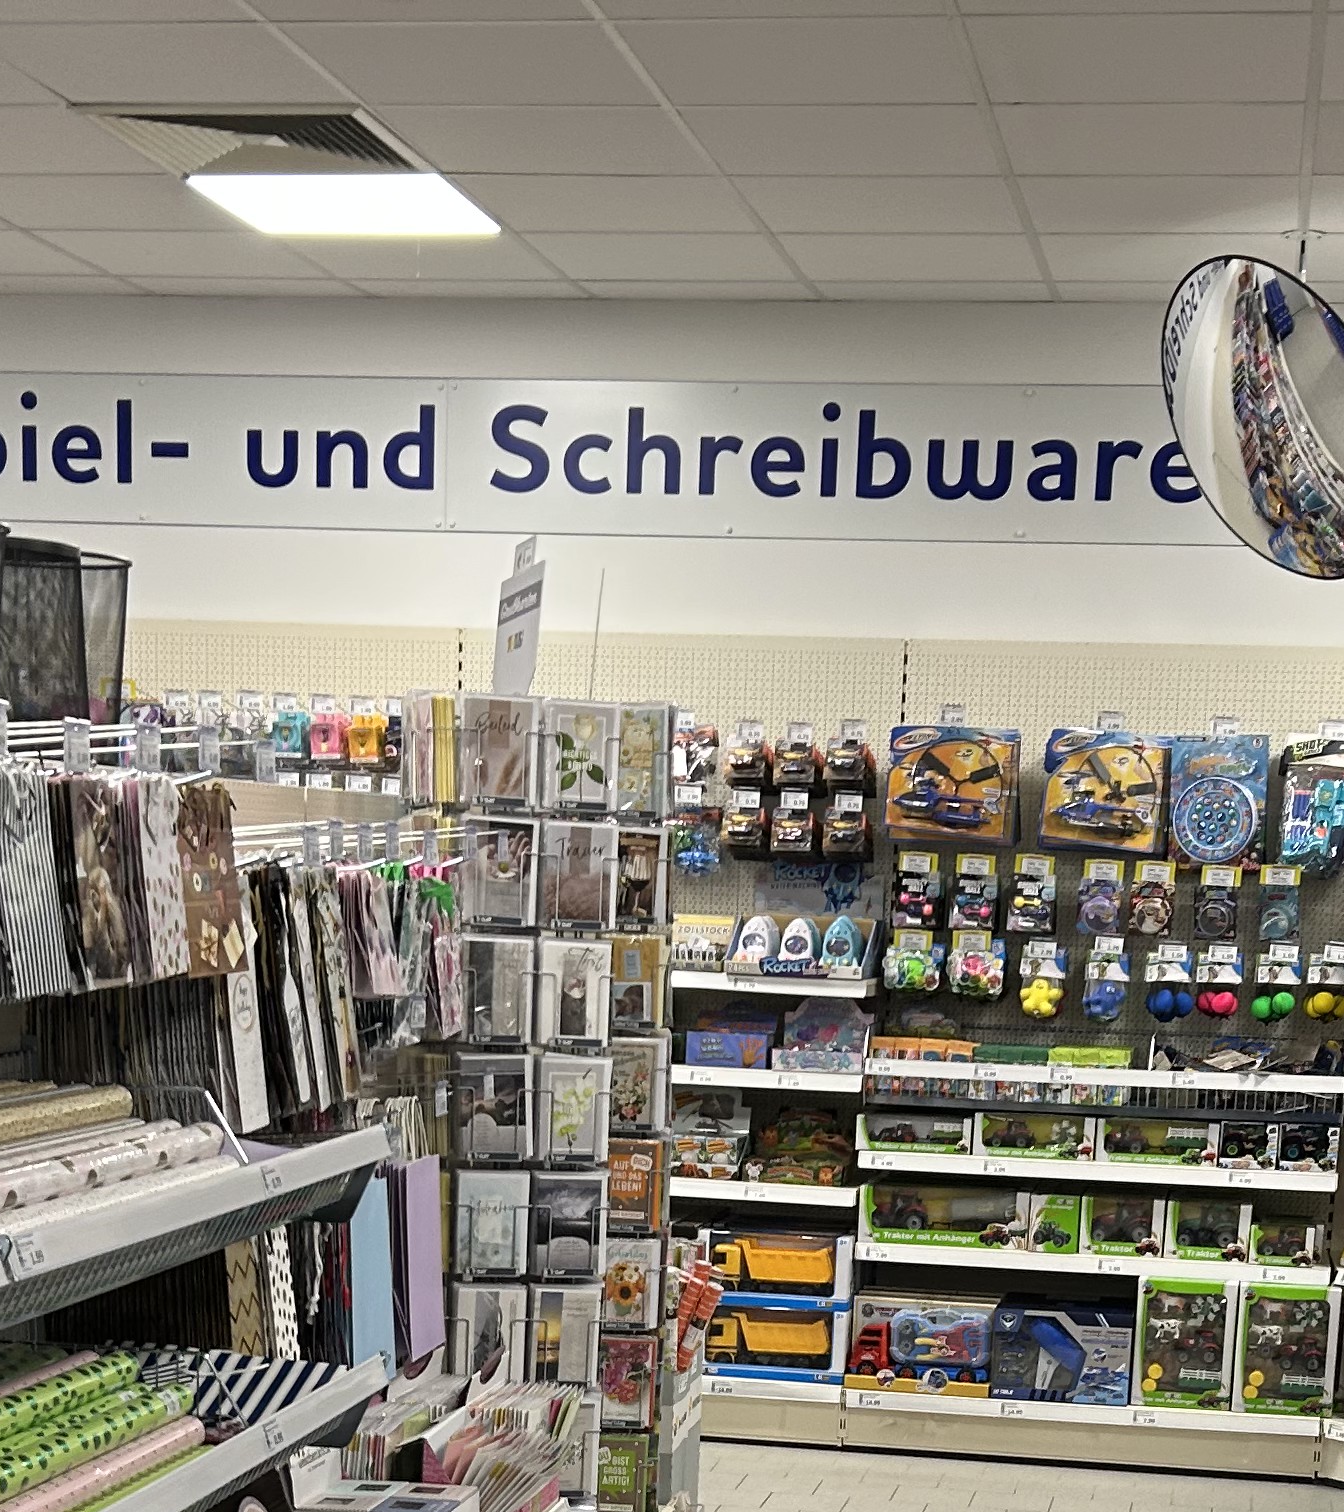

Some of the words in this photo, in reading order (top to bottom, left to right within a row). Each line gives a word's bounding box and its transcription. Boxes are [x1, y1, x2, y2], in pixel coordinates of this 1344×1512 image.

[246, 404, 435, 490] und
[489, 402, 1207, 504] Schreibware
[556, 836, 606, 860] Trauer
[763, 959, 806, 974] ROCKET
[613, 1160, 628, 1170] AUF
[611, 1181, 642, 1191] LEBEN!
[882, 1232, 914, 1241] Traktor
[932, 1233, 976, 1243] Anhänger
[1101, 1245, 1133, 1253] Traktor
[1187, 1249, 1221, 1259] Traktor
